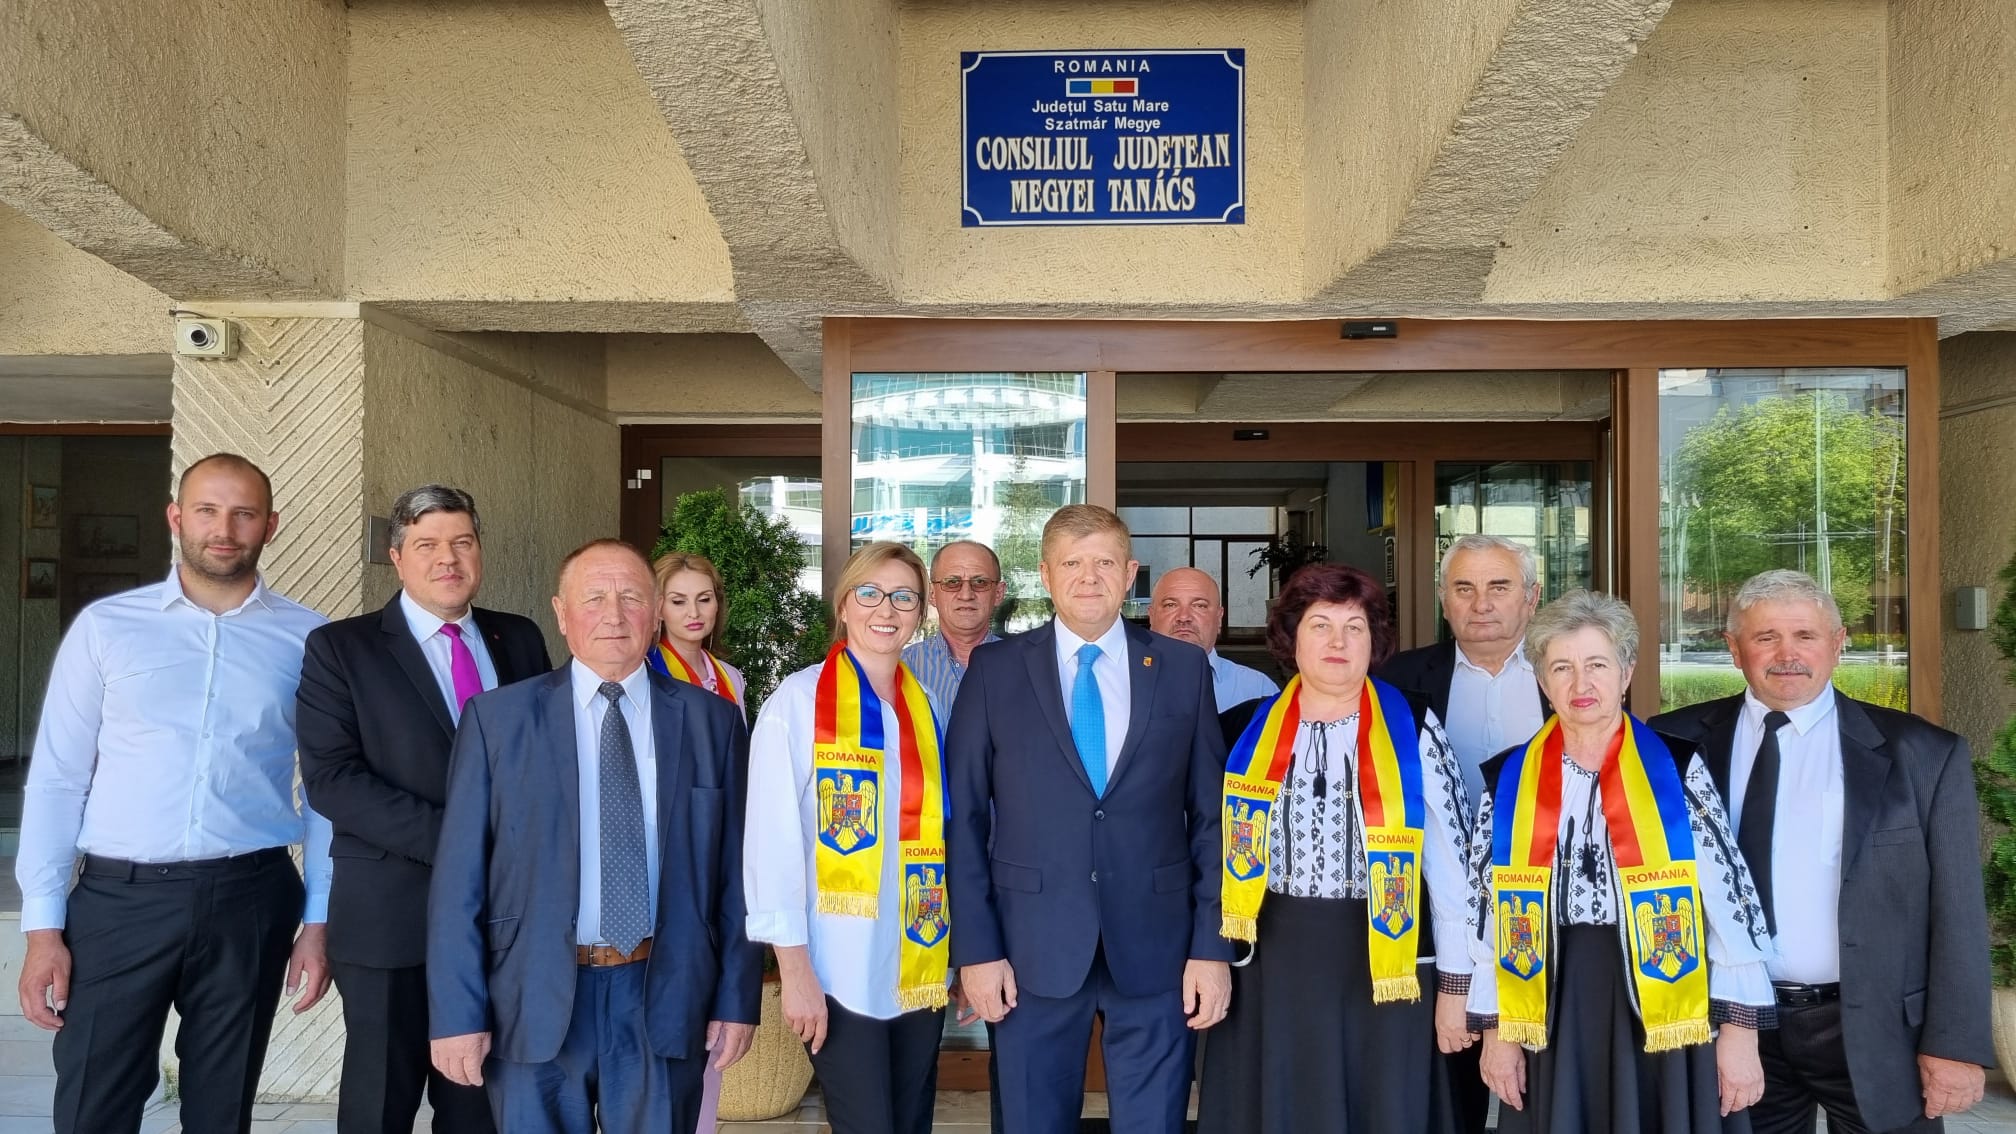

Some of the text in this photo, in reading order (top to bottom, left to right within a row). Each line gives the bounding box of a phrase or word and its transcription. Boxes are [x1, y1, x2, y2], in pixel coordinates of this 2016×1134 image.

[1054, 60, 1150, 73] ROMANIA
[1032, 100, 1169, 116] Județul Satu Mare
[1044, 117, 1161, 133] Szatmár Megye
[976, 136, 1093, 171] CONSILIUL
[1010, 179, 1095, 213] MEGYEI
[816, 751, 877, 765] ROMANIA
[1226, 779, 1275, 796] ROMANIA
[1367, 834, 1415, 845] ROMANIA
[905, 847, 945, 857] ROMAN
[1497, 873, 1544, 884] ROMANIA
[1626, 868, 1690, 885] ROMANIA
